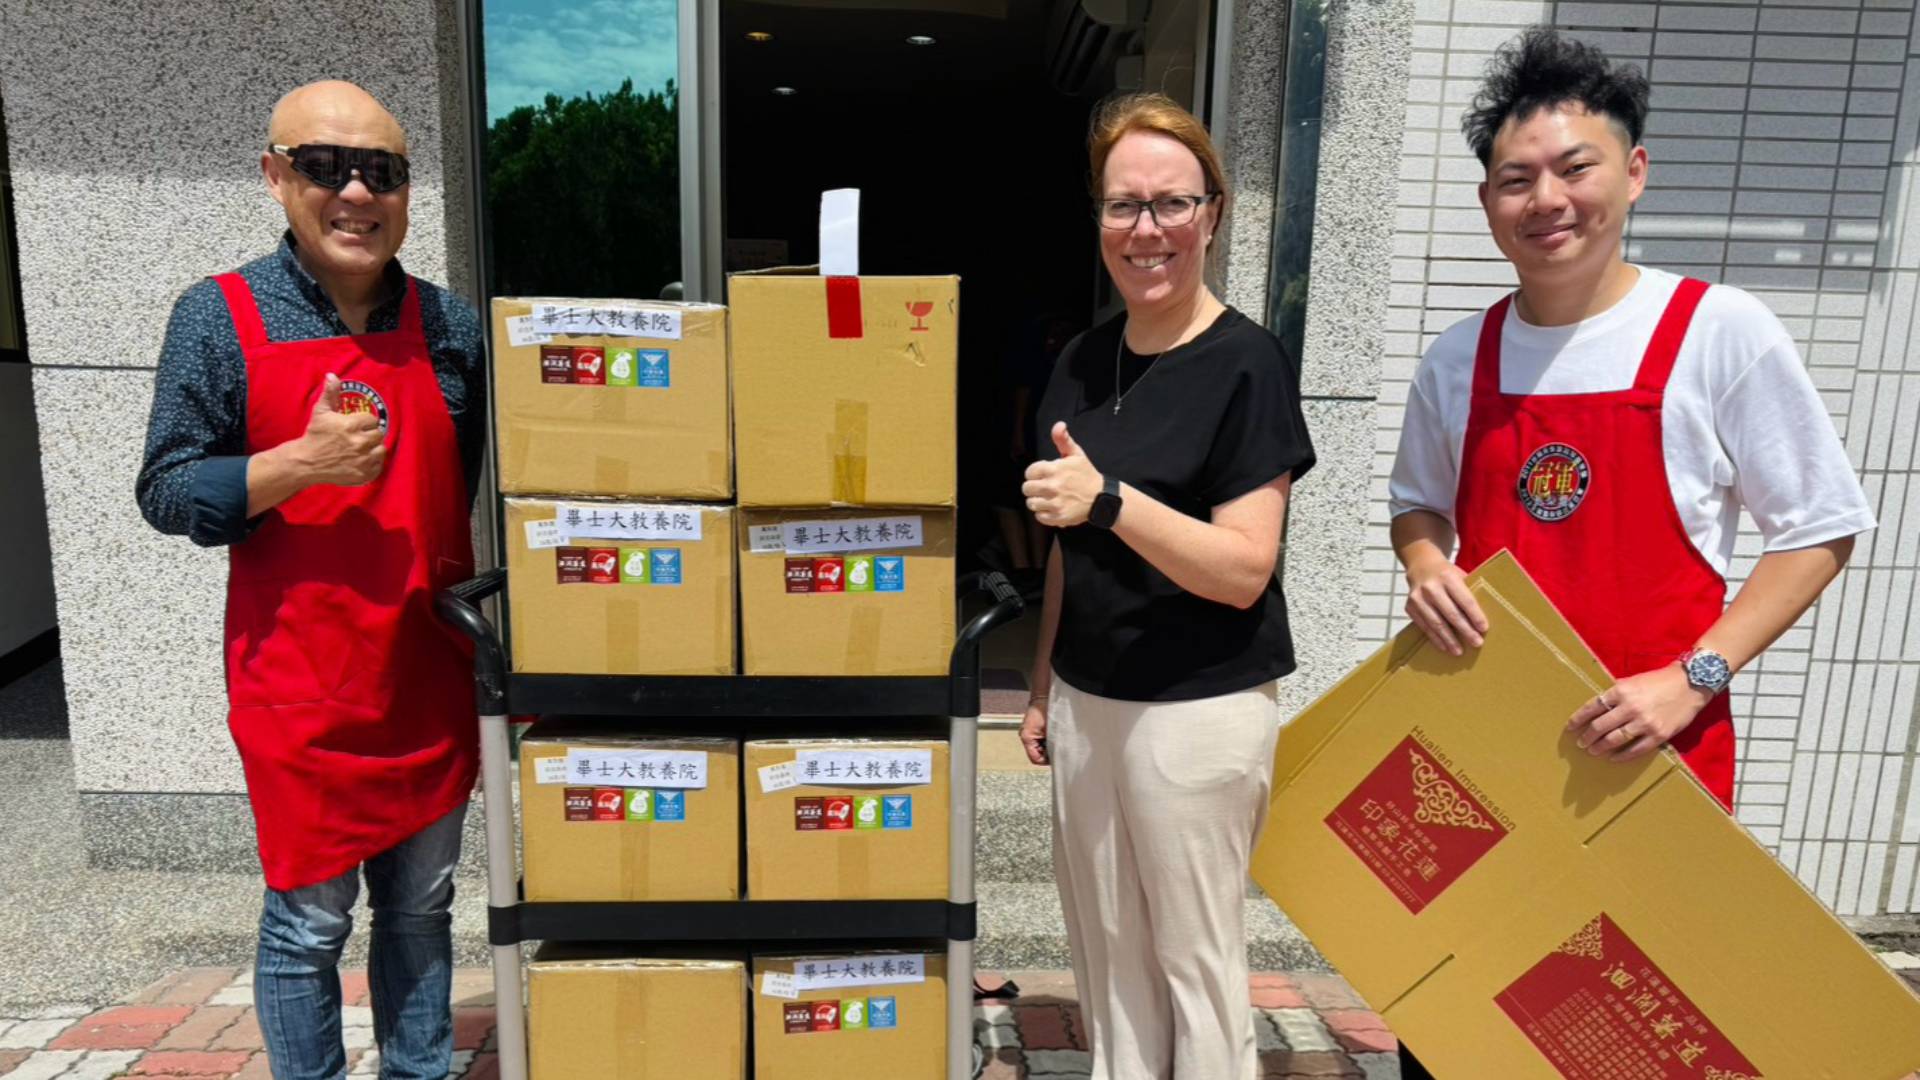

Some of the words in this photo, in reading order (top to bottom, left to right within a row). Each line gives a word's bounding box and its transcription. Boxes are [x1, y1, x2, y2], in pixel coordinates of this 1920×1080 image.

[541, 306, 673, 332] 畢士大教養院
[566, 509, 693, 531] 畢士大教養院
[793, 522, 914, 546] 畢士大教養院
[576, 759, 698, 780] 畢士大教養院
[804, 760, 923, 779] 畢士大教養院
[1411, 725, 1453, 769] Hualien
[1456, 769, 1516, 831] Impression
[1360, 799, 1440, 882] 印象花蓮
[803, 959, 917, 980] 畢士大教養院
